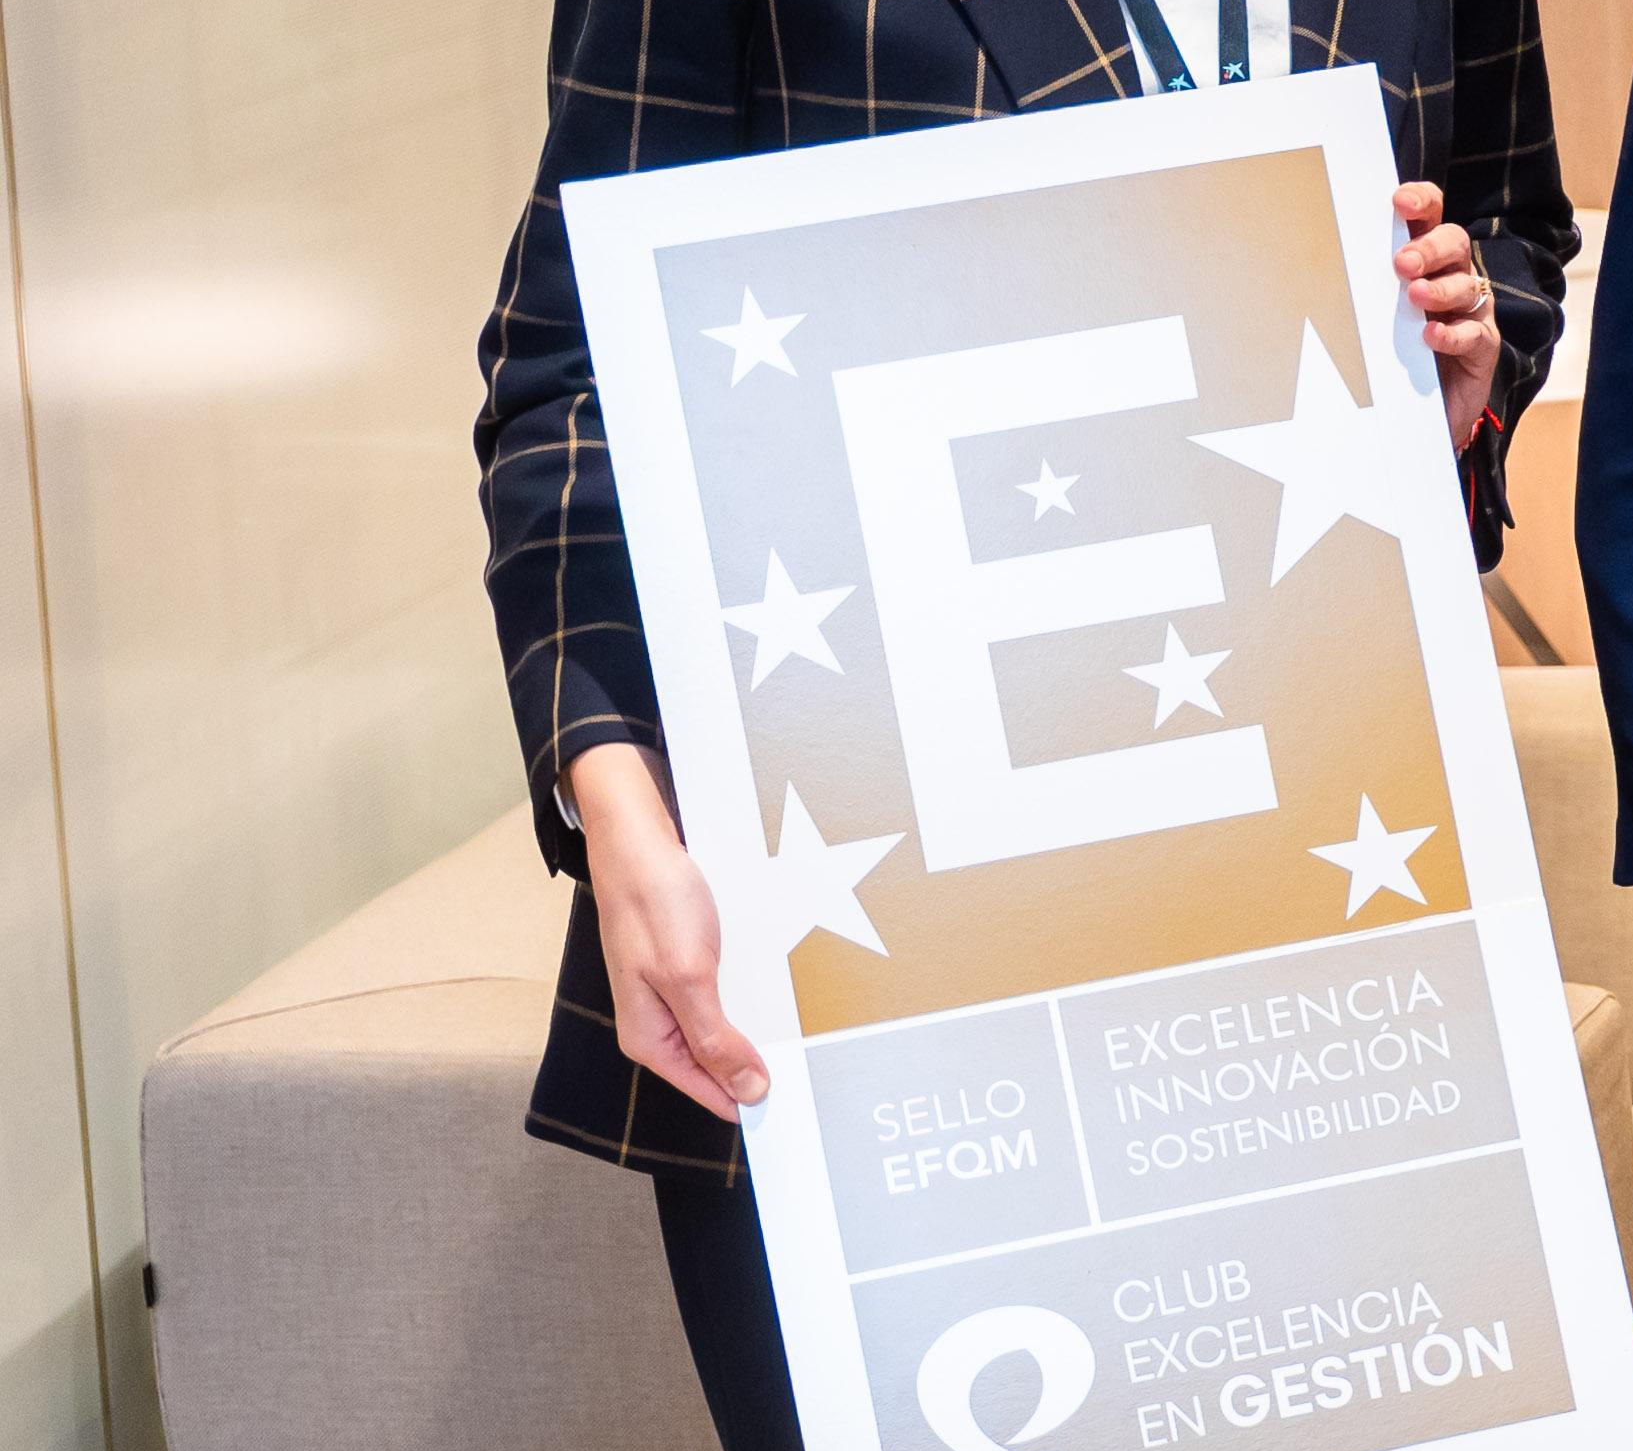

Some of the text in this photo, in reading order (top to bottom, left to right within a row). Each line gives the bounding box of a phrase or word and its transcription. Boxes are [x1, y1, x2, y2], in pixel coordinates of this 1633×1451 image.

[832, 314, 1277, 873] E
[1103, 968, 1445, 1071] EXCELENCIA
[872, 1079, 1027, 1143] SELLO
[1113, 1022, 1453, 1125] INNOVACIÓN
[882, 1129, 1039, 1196] EFQM
[1125, 1079, 1462, 1176] SOSTENIBILIDAD
[1112, 1258, 1252, 1323] CLUB
[1123, 1280, 1443, 1384] EXCELENCIA
[1136, 1320, 1515, 1449] EN GESTIÓN
